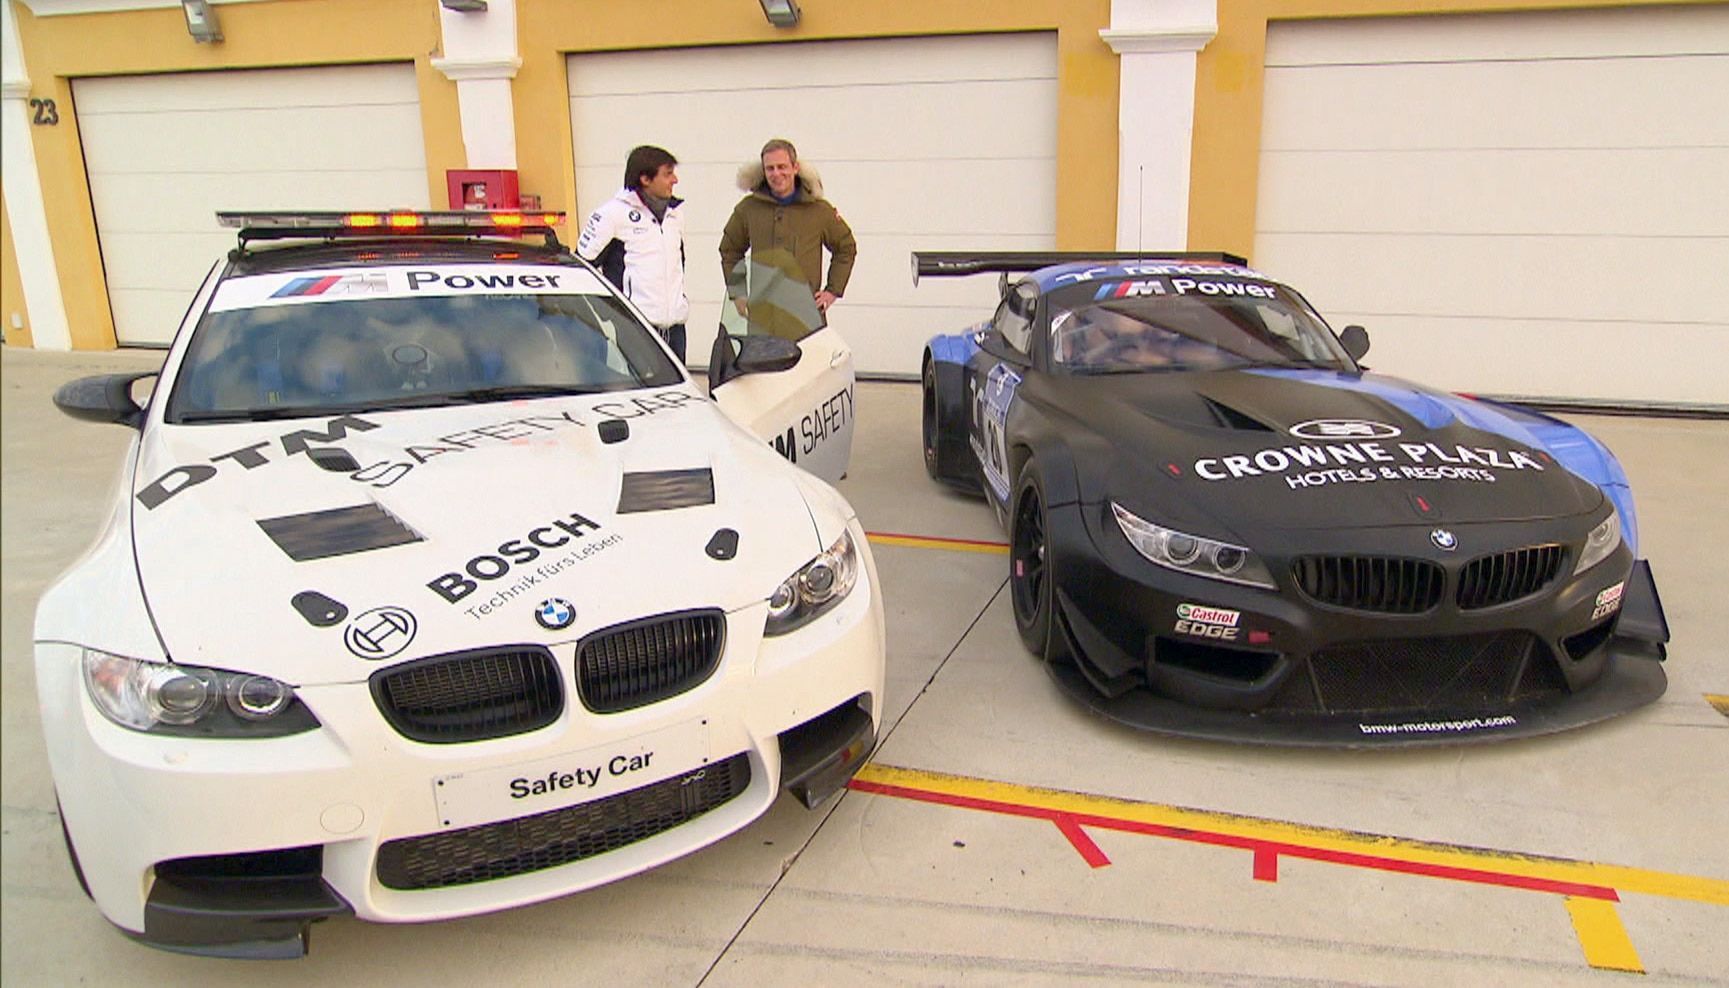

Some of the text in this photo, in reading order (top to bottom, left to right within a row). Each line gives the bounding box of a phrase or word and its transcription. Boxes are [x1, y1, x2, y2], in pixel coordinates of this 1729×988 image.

[30, 99, 59, 125] 23
[406, 271, 561, 290] Power
[1171, 278, 1276, 299] Power
[801, 383, 853, 455] SAFETY
[350, 390, 706, 488] SAFETY CAR
[136, 414, 382, 511] DTM
[1194, 442, 1545, 481] CROWNE PLAZA
[1285, 466, 1496, 489] HOTELS & RESORTS
[426, 513, 601, 604] BOSCH
[464, 574, 541, 622] Technik
[537, 556, 575, 580] fürs
[571, 533, 624, 561] Leben
[1174, 620, 1240, 640] EDGE
[1192, 607, 1235, 624] Castrol
[1359, 715, 1516, 734] bmw-motorsport.com
[510, 752, 654, 799] Safety Car
